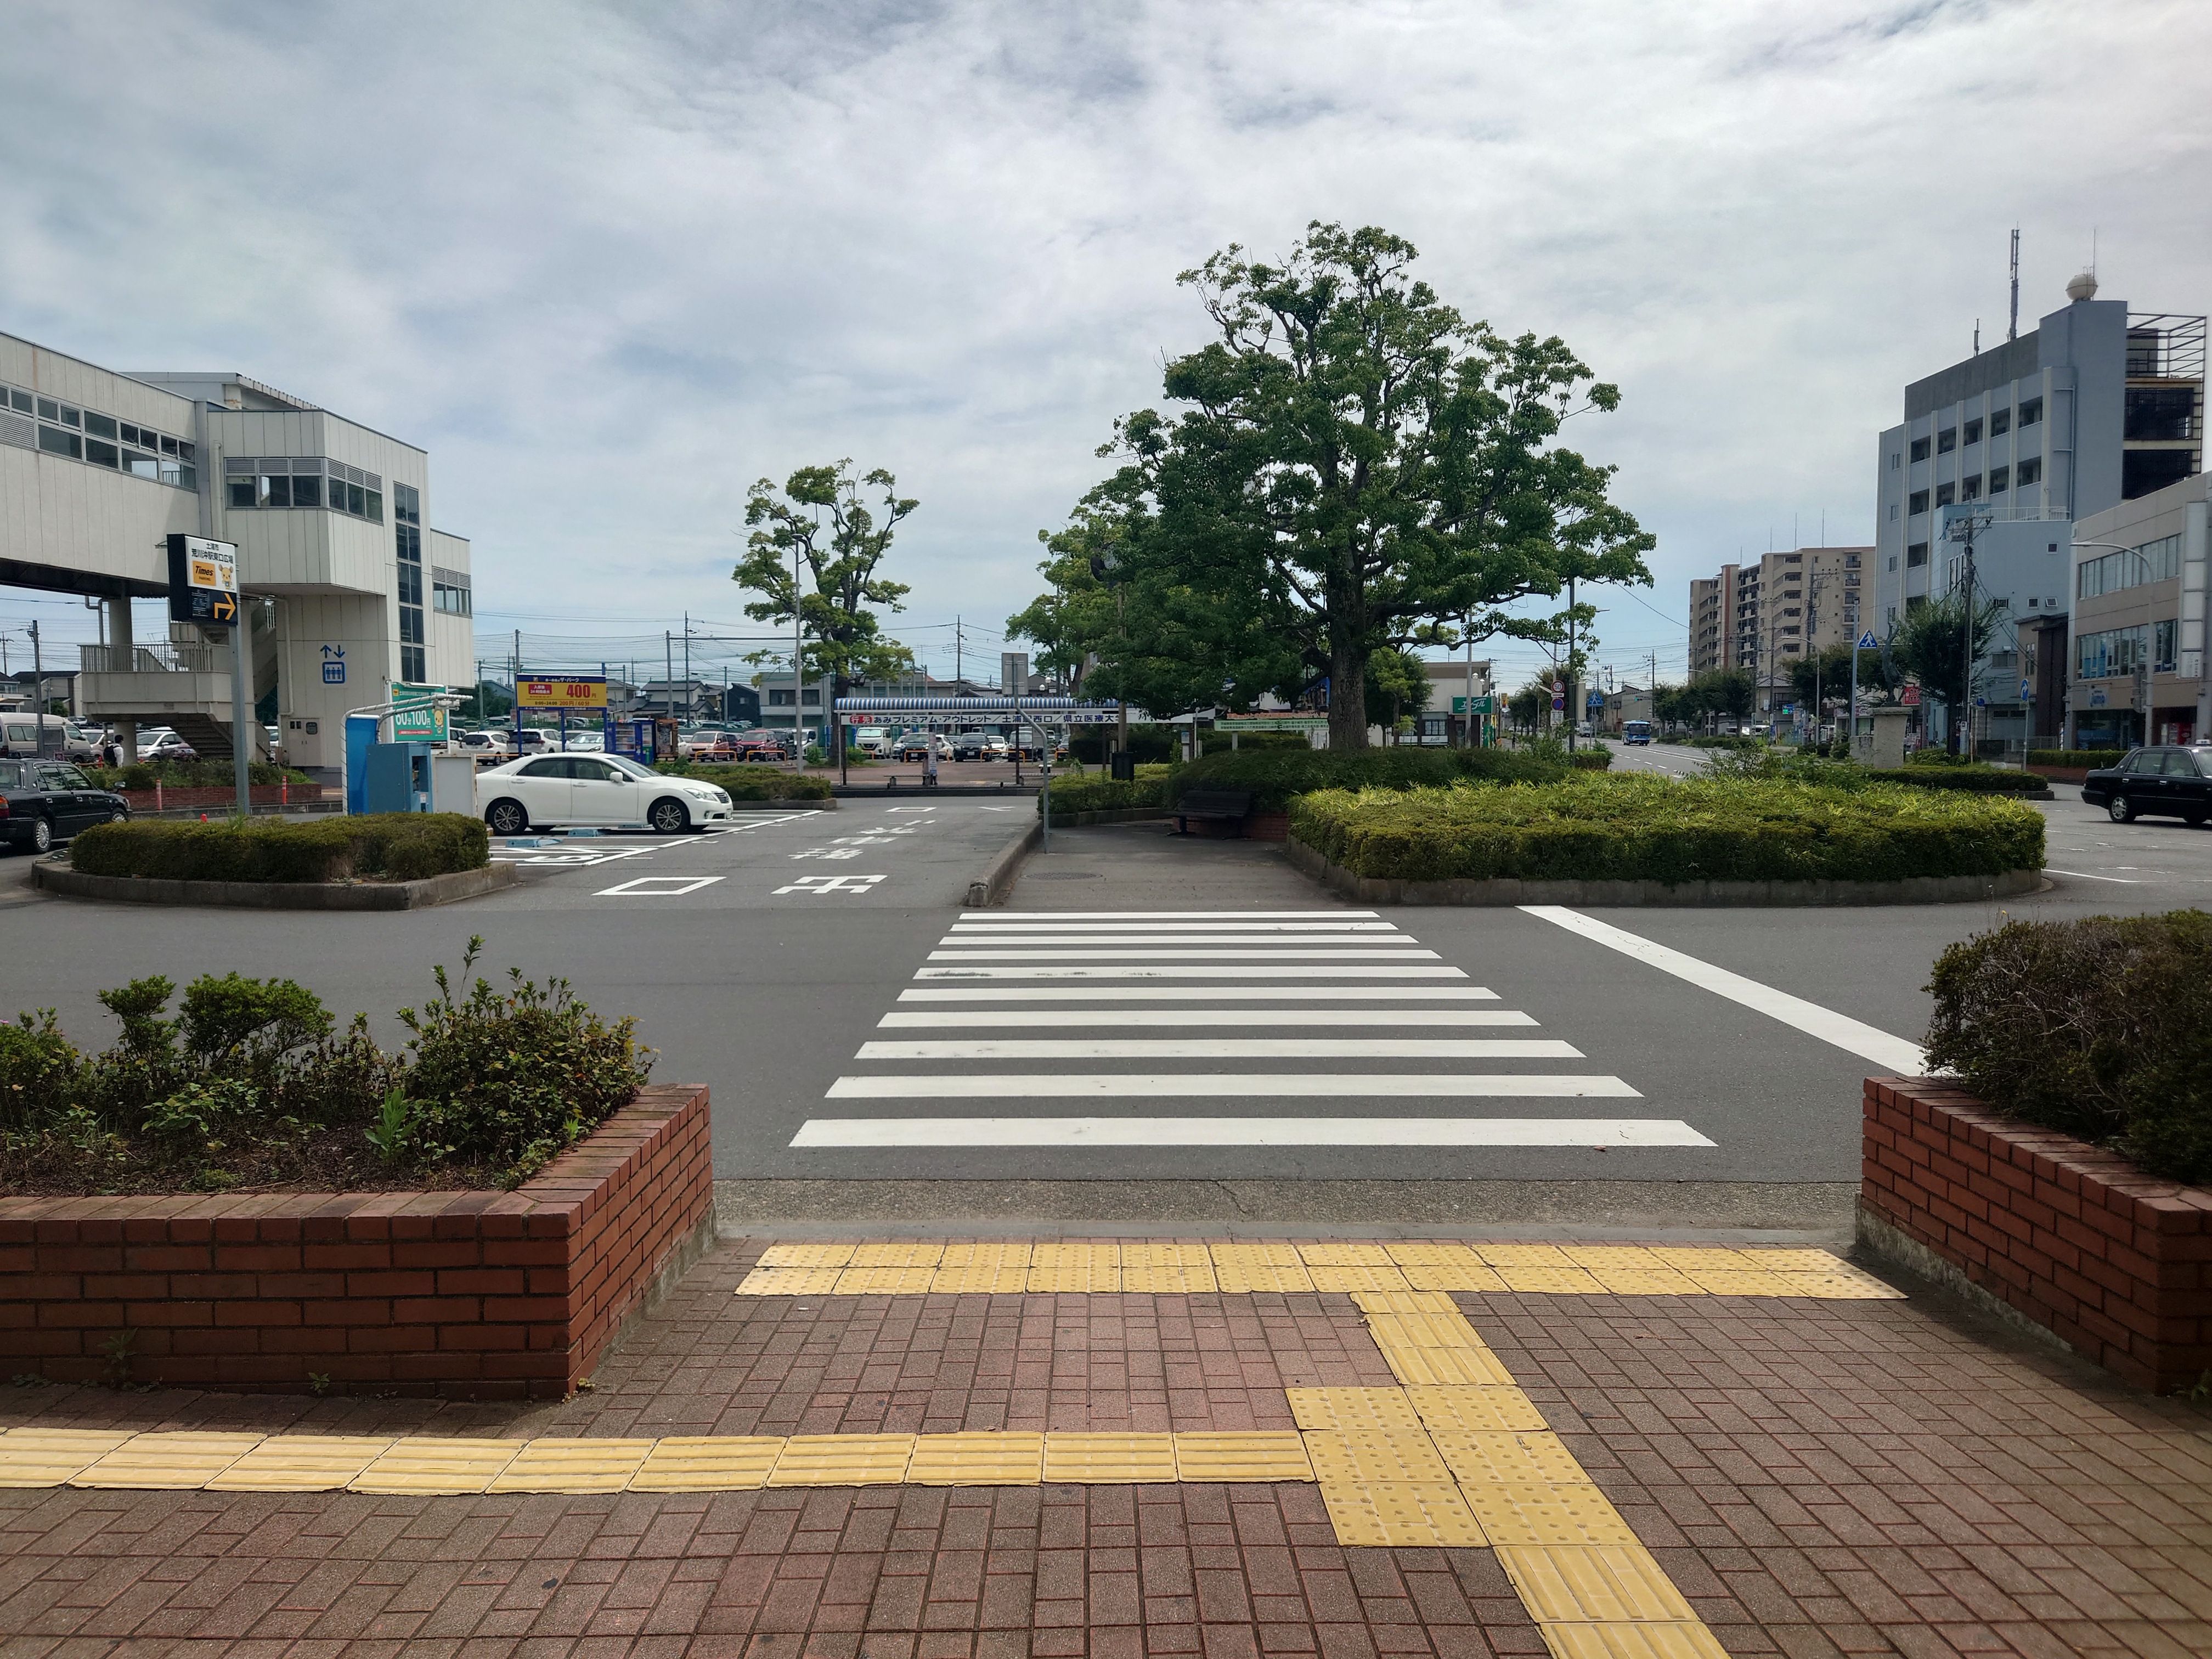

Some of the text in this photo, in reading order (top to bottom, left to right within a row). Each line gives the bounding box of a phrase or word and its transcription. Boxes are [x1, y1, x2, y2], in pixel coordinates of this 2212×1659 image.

[195, 566, 213, 576] Times
[1458, 698, 1486, 710] エブル
